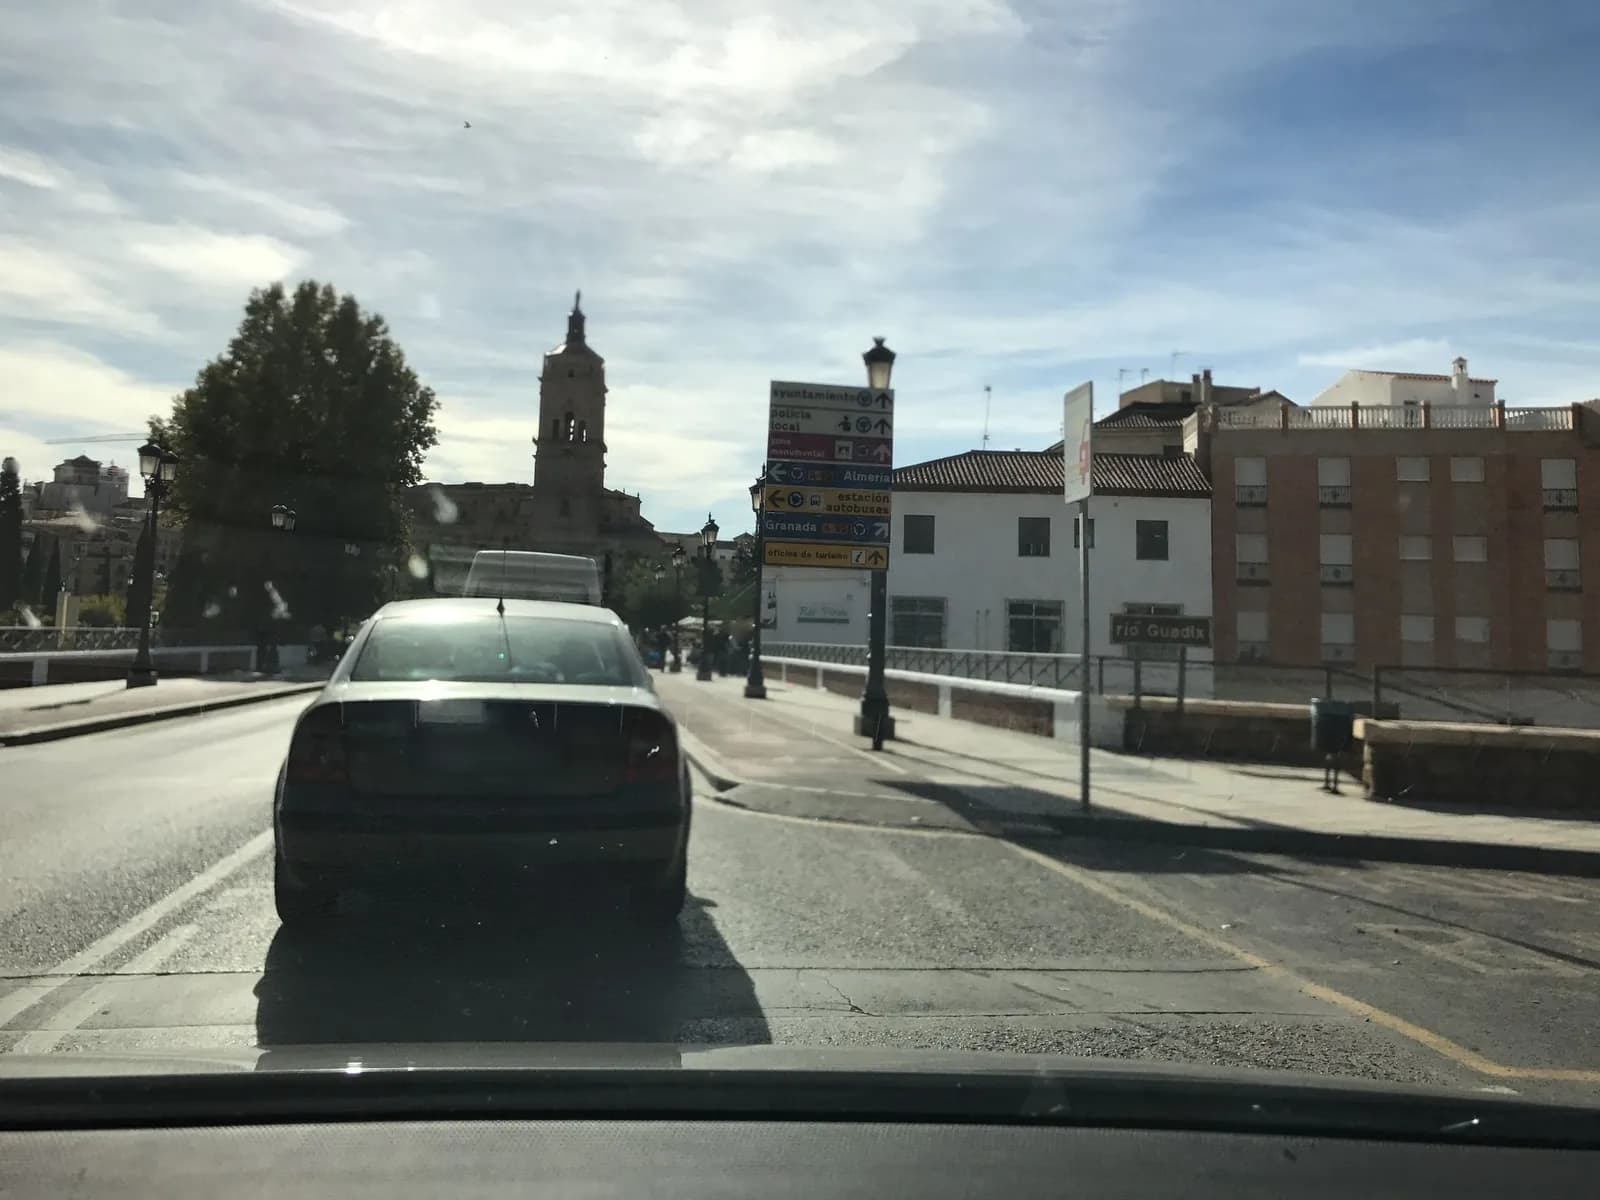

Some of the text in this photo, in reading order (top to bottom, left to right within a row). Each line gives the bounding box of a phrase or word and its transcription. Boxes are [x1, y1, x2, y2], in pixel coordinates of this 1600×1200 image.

[770, 421, 801, 432] local
[826, 504, 889, 514] autobuses
[766, 519, 817, 533] Granada
[767, 547, 798, 558] oficina
[801, 549, 813, 559] de
[1147, 623, 1205, 640] Guadix
